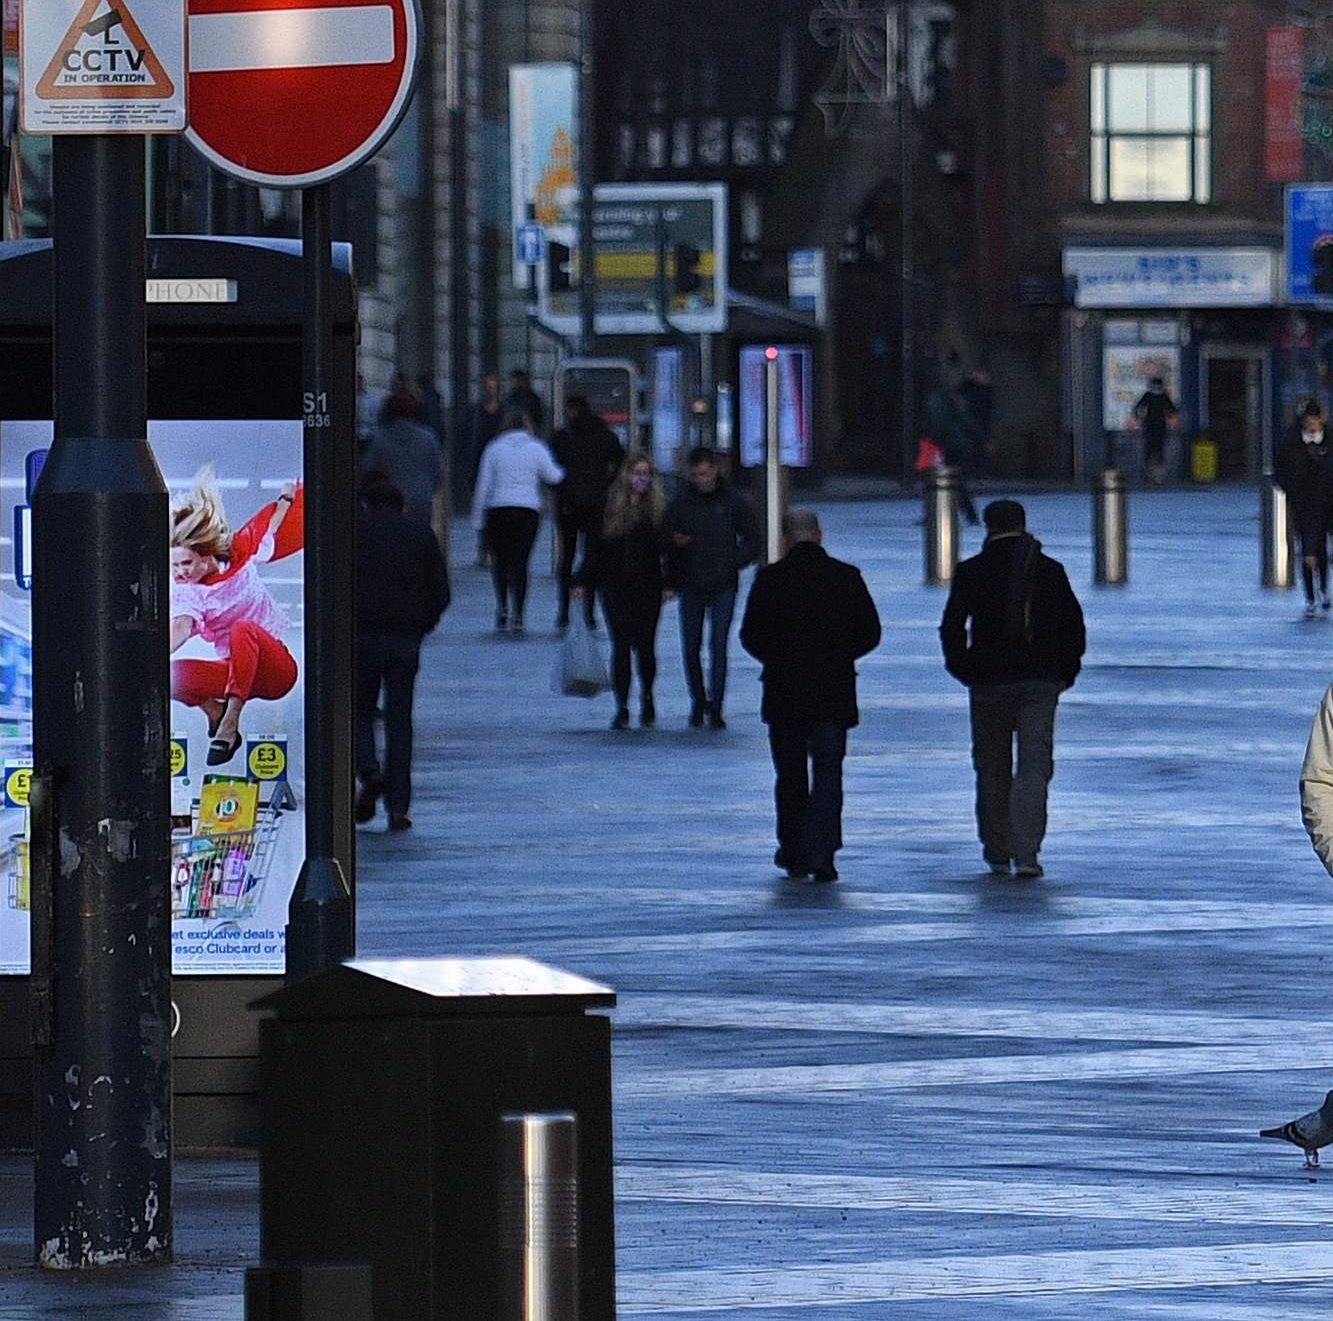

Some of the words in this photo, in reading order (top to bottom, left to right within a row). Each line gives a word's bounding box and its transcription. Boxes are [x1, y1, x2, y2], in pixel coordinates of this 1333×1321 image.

[63, 49, 146, 72] CCTV
[64, 74, 77, 83] IN
[81, 74, 146, 83] OPERATION
[304, 392, 327, 413] S1
[304, 414, 330, 428] 636
[257, 747, 277, 762] £3
[171, 929, 184, 940] et
[187, 928, 241, 940] exclusive
[243, 928, 275, 940] deals
[174, 944, 204, 955] esco
[206, 942, 261, 955] Clubcard
[264, 945, 278, 955] or
